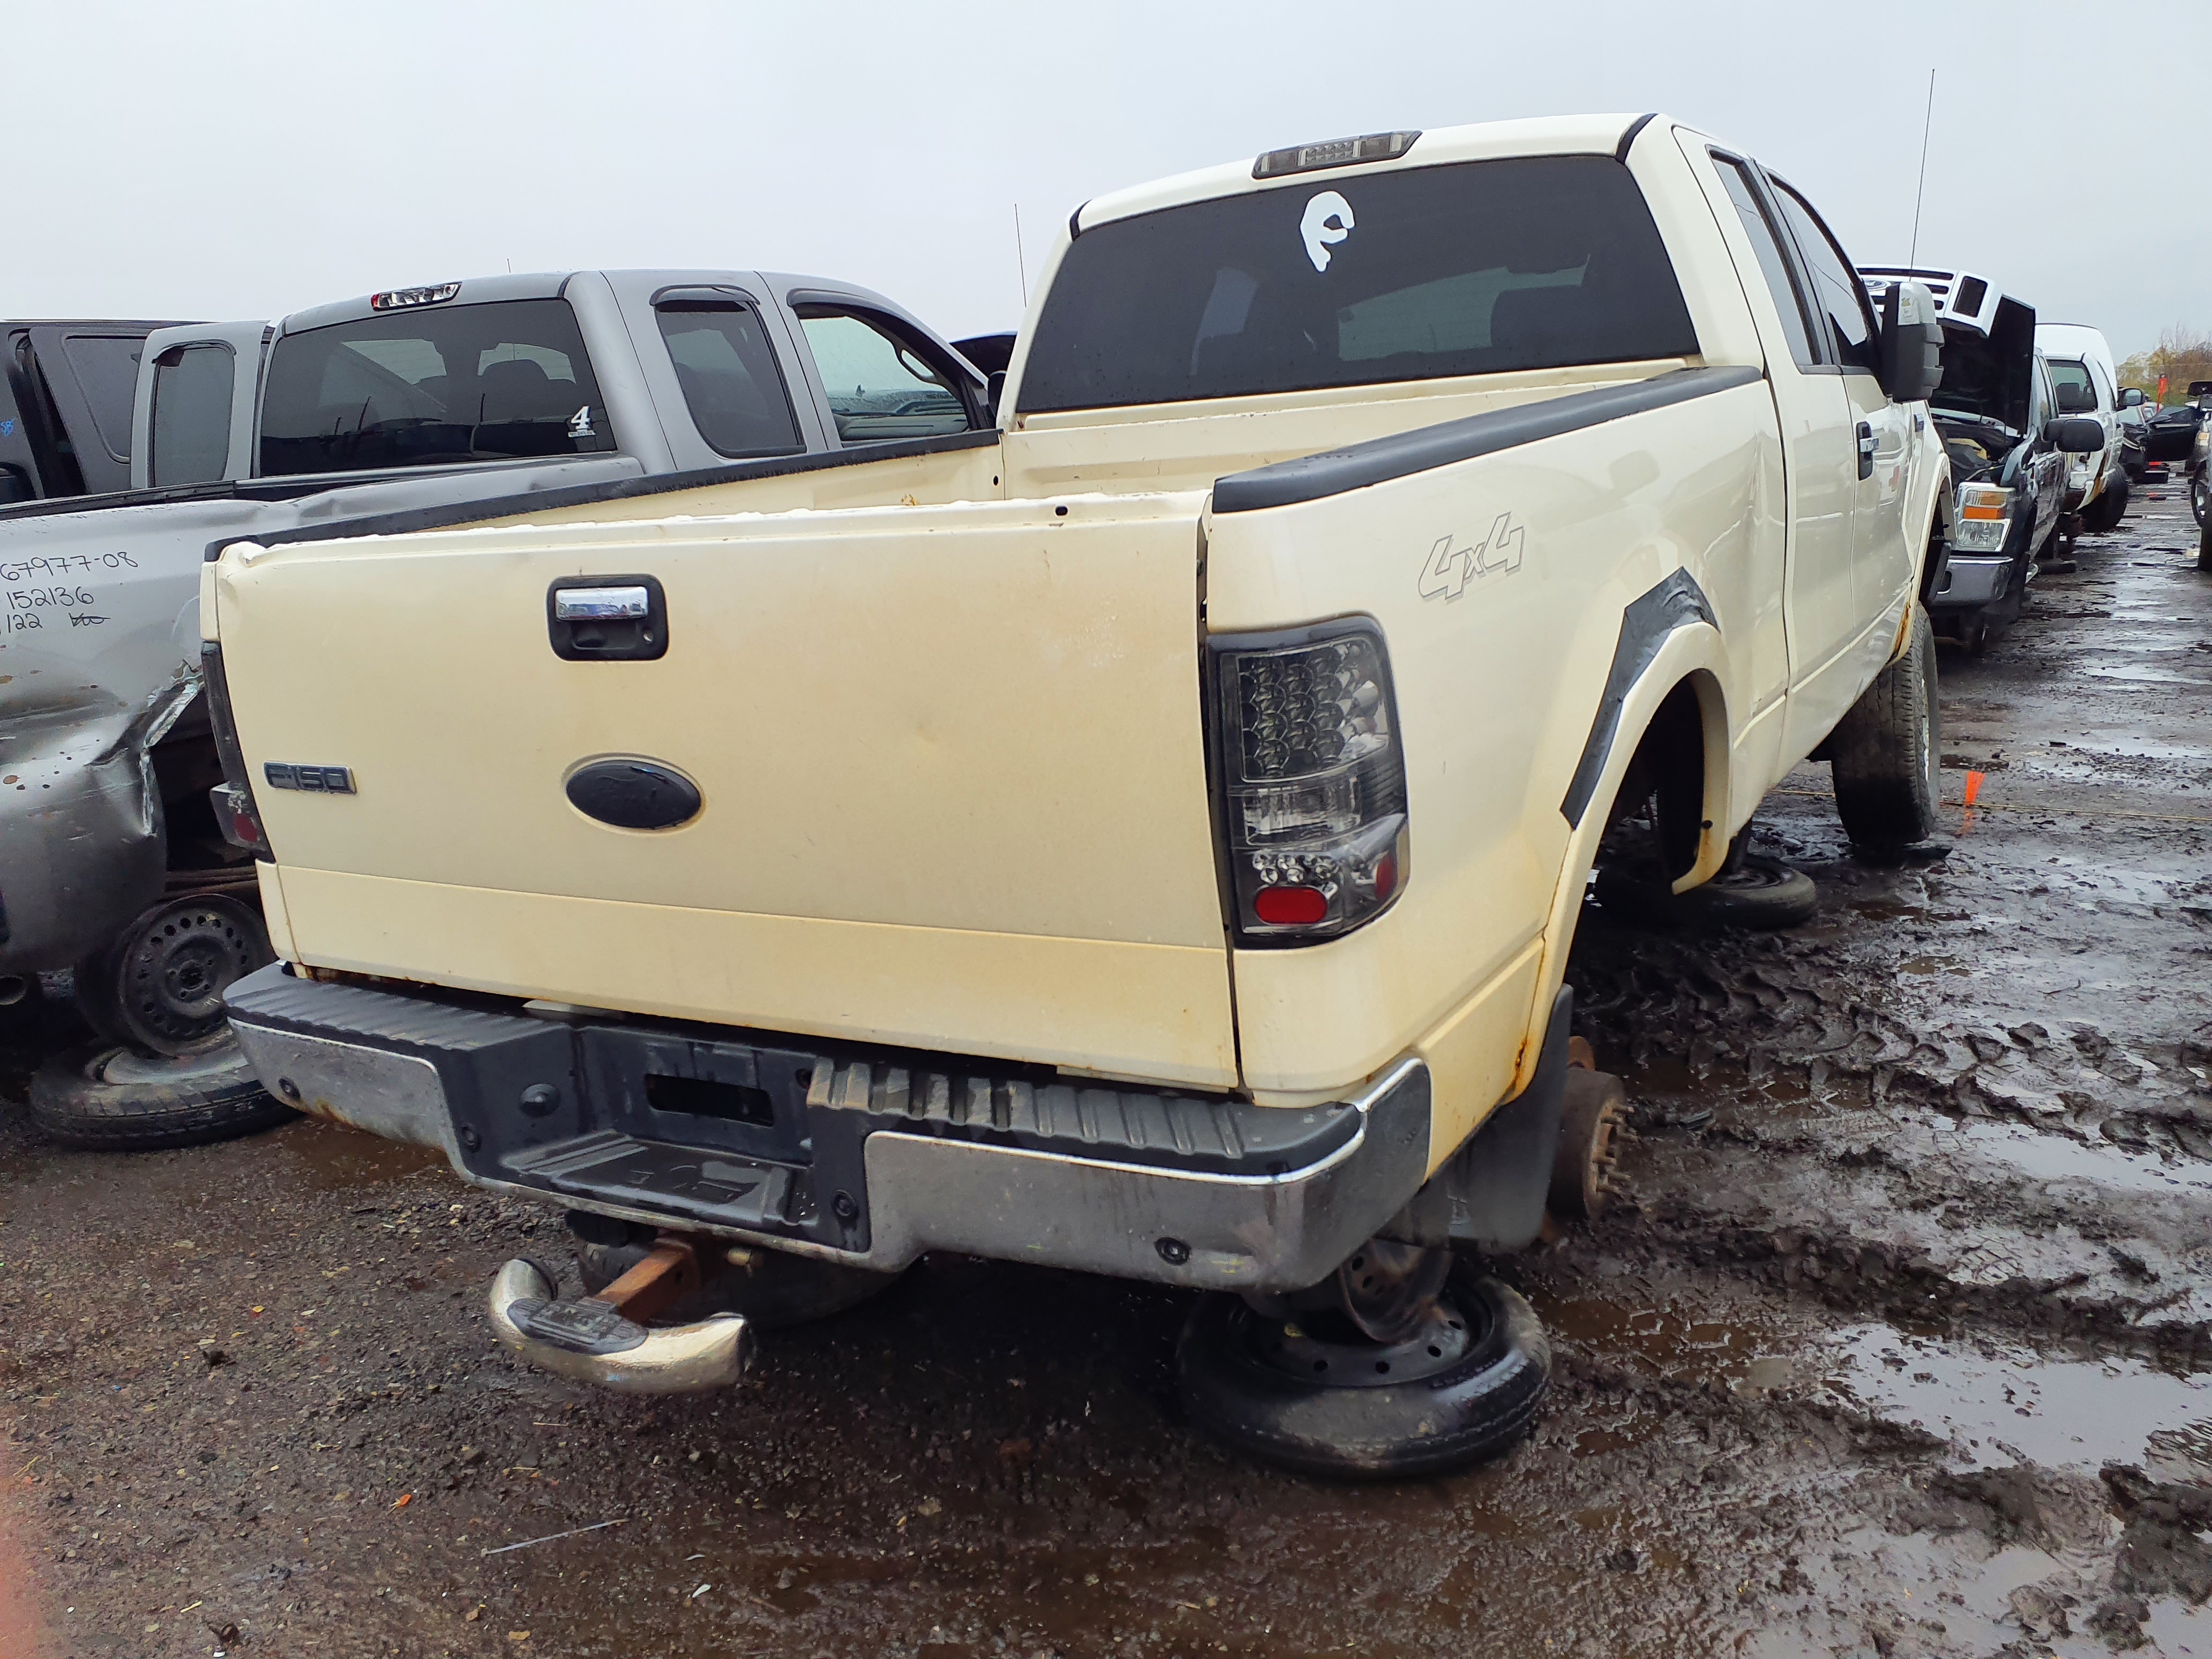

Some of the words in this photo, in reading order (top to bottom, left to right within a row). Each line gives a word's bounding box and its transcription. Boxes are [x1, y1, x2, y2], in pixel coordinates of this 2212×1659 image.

[571, 406, 591, 429] 4
[0, 551, 138, 581] 67977-08
[1418, 511, 1525, 601] 4x4
[6, 586, 94, 610] 152136
